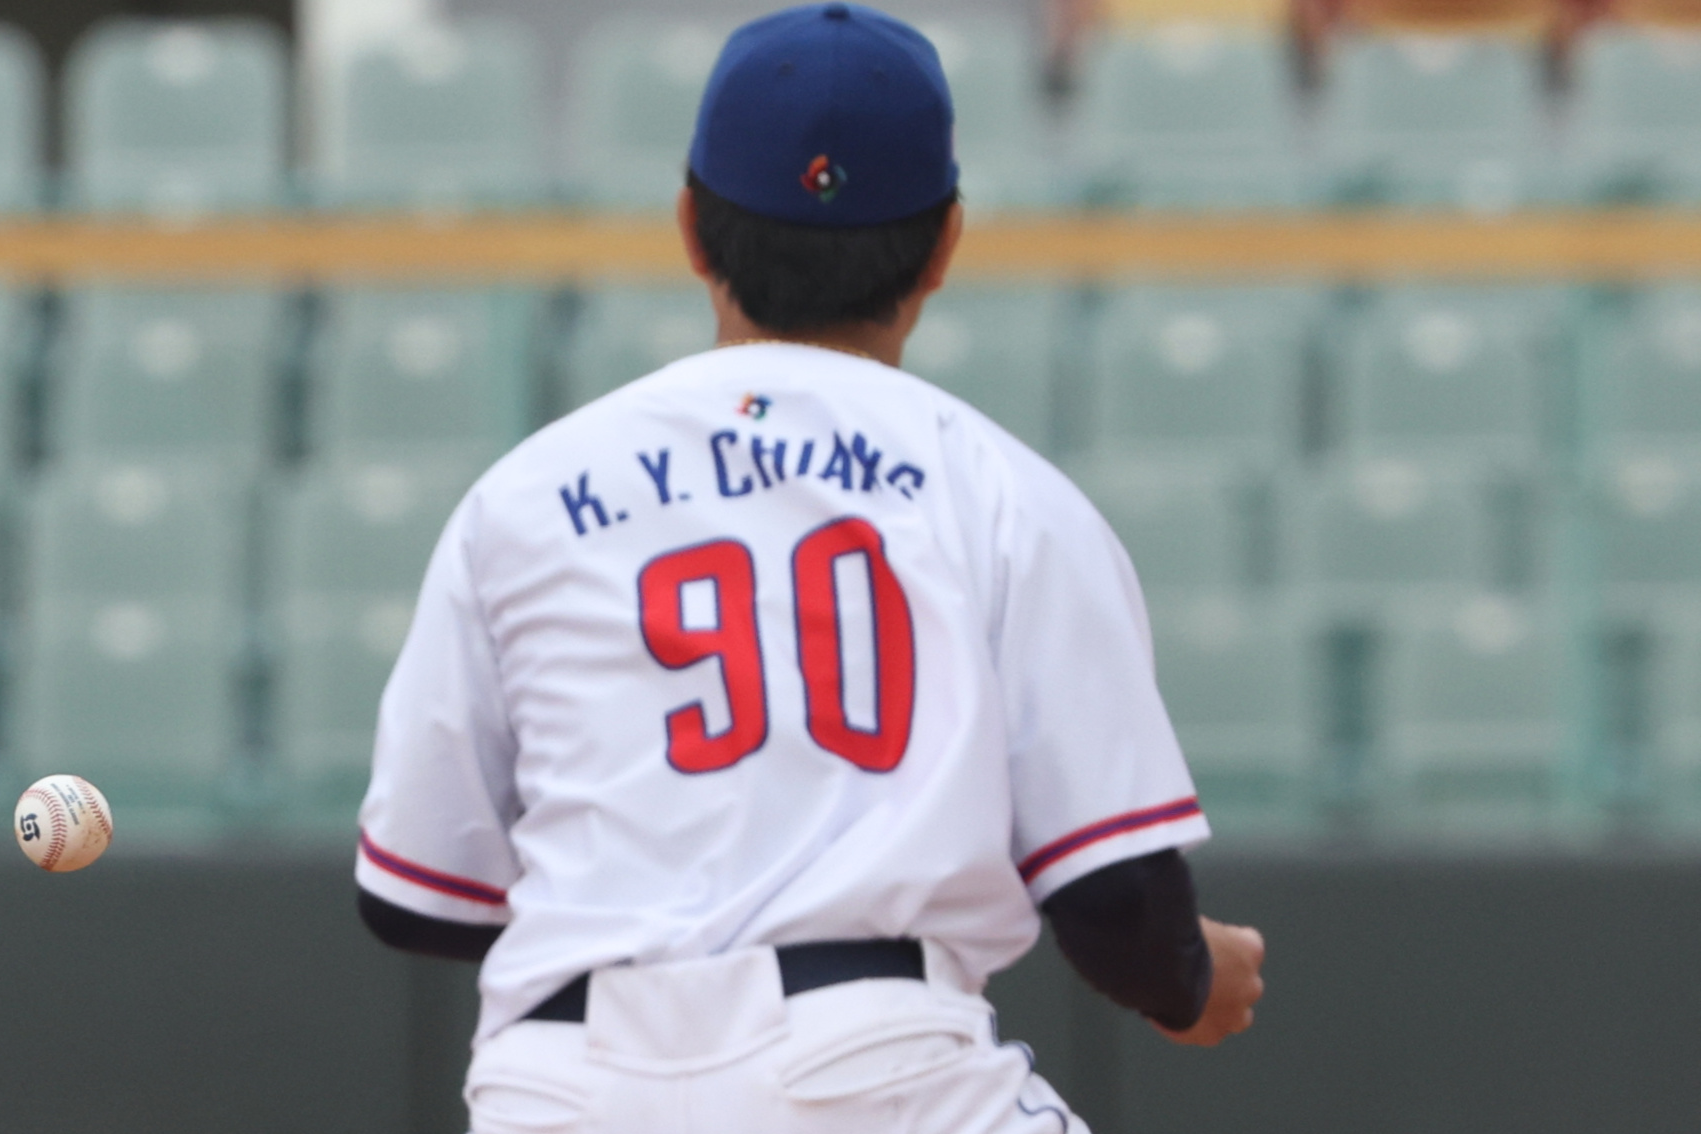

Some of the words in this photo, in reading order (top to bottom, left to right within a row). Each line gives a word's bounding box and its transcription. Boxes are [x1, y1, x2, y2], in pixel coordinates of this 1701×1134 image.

[558, 470, 630, 536] K.
[637, 447, 692, 505] Y.
[637, 514, 916, 775] 90
